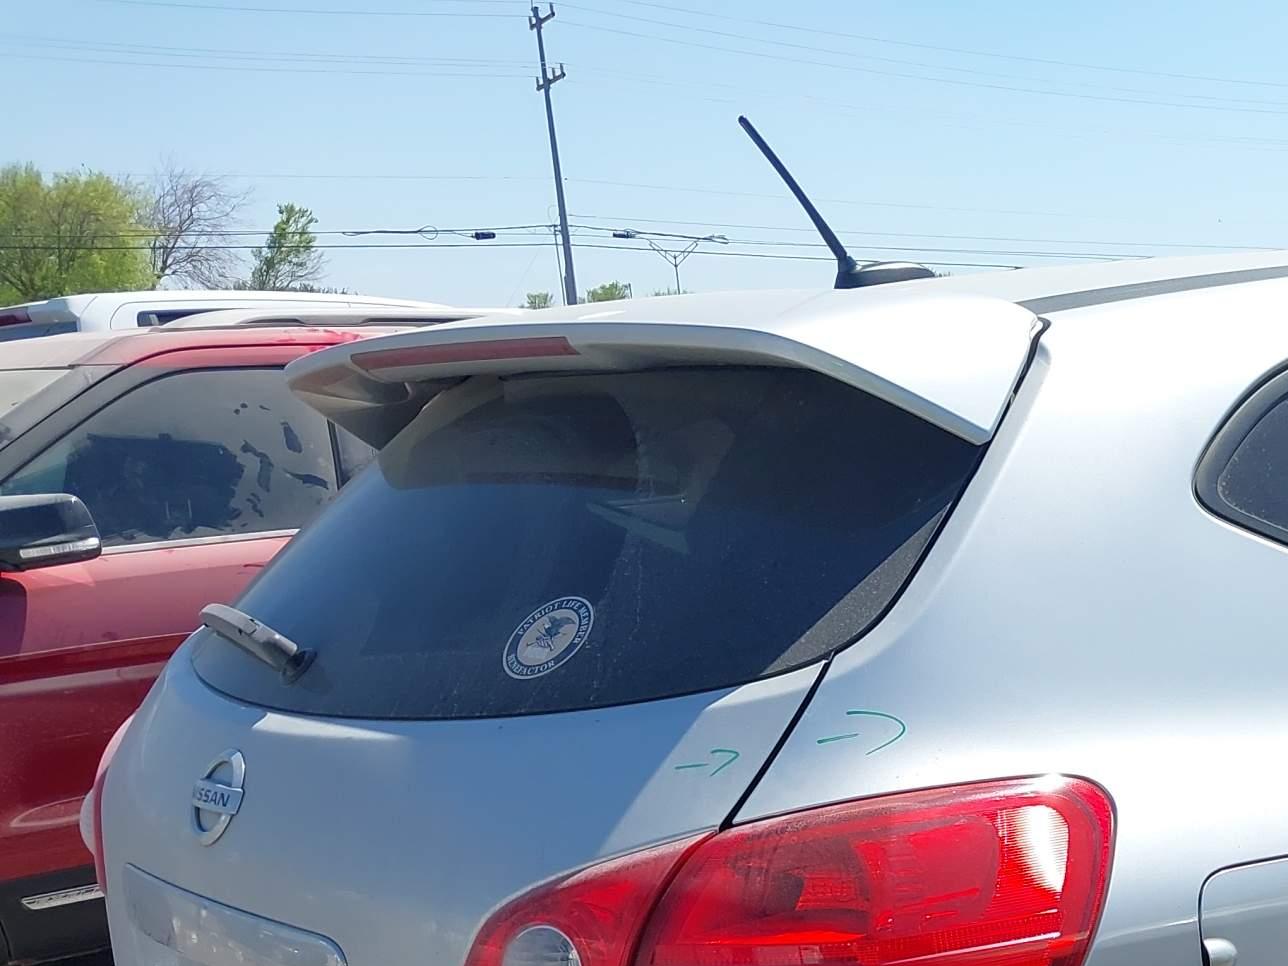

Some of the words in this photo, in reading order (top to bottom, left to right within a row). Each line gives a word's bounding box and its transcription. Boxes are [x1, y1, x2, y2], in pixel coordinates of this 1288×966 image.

[518, 602, 562, 635] PATRIOT
[562, 600, 580, 610] LIFE
[573, 605, 590, 644] MEMBER
[507, 654, 556, 675] BENEFACTOR
